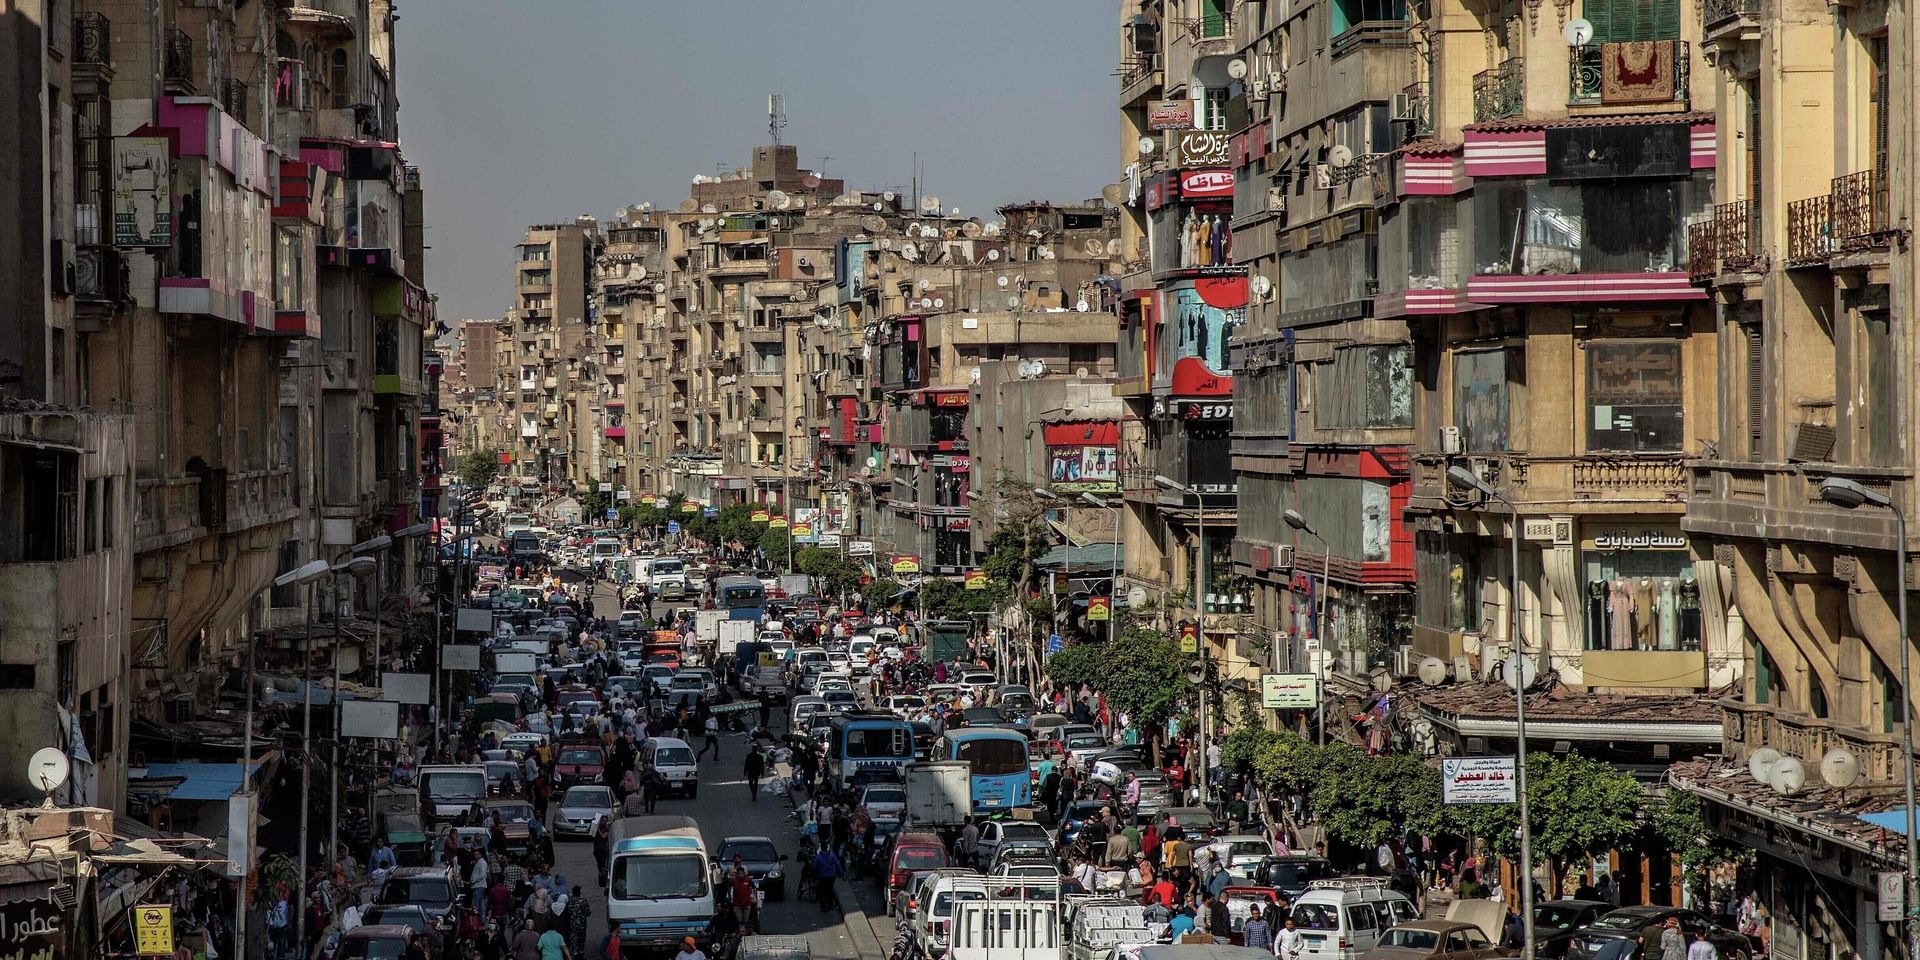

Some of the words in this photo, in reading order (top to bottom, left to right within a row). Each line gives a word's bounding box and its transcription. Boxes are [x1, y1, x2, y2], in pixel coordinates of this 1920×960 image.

[1150, 109, 1173, 122] الشام
[1181, 133, 1216, 156] الشام
[1208, 155, 1228, 164] لابس
[952, 459, 970, 469] وده
[1594, 530, 1650, 550] للعبايات
[1650, 530, 1686, 546] مسك
[1488, 771, 1504, 780] خالد
[11, 906, 59, 944] عطور
